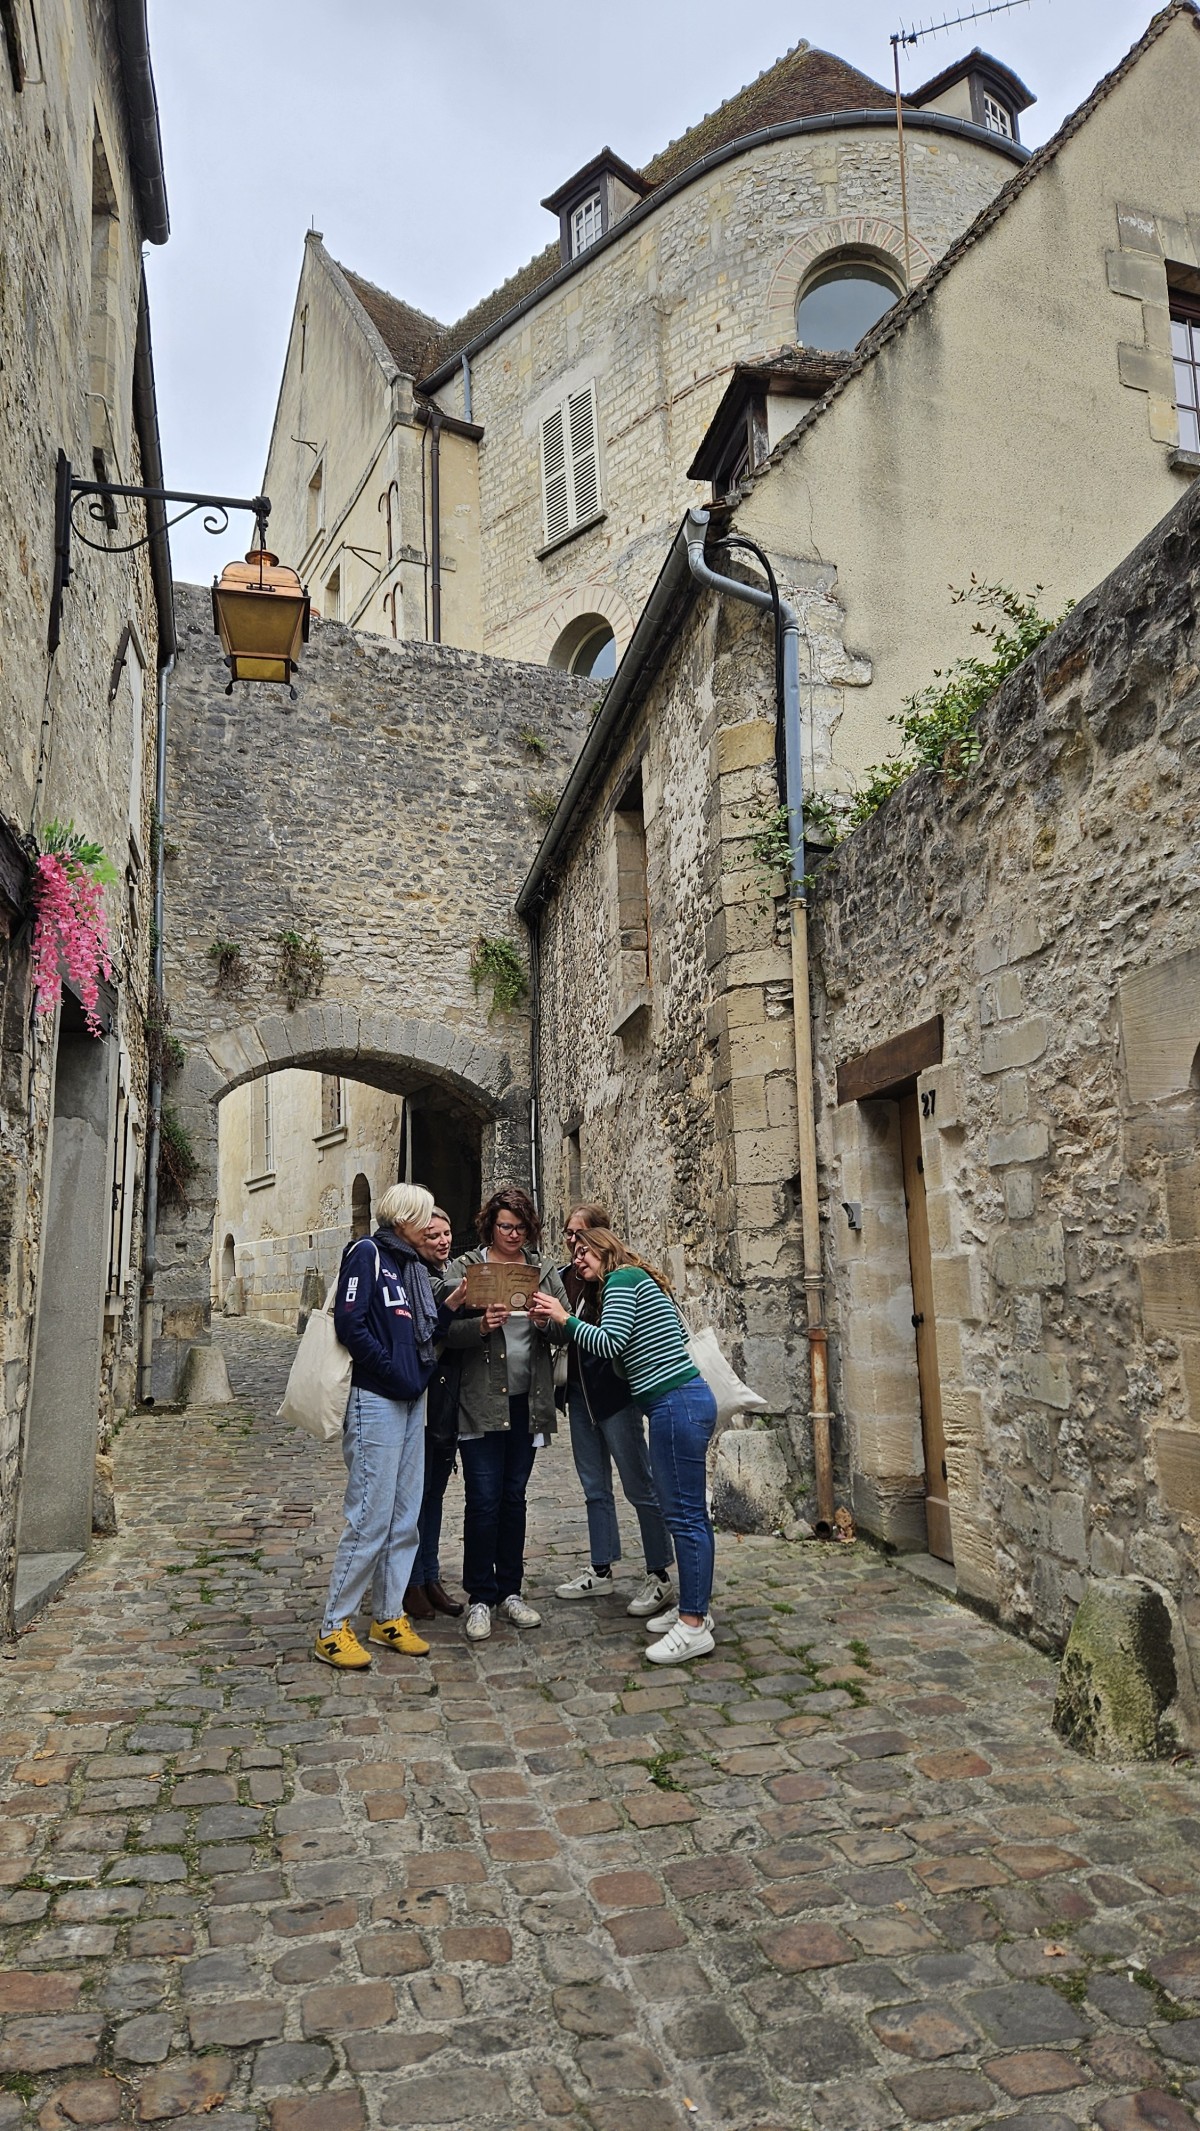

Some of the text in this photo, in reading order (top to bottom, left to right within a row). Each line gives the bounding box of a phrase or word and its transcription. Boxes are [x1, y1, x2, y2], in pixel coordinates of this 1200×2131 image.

[921, 1090, 936, 1117] 27
[383, 1627, 402, 1640] N
[324, 1642, 342, 1655] N
